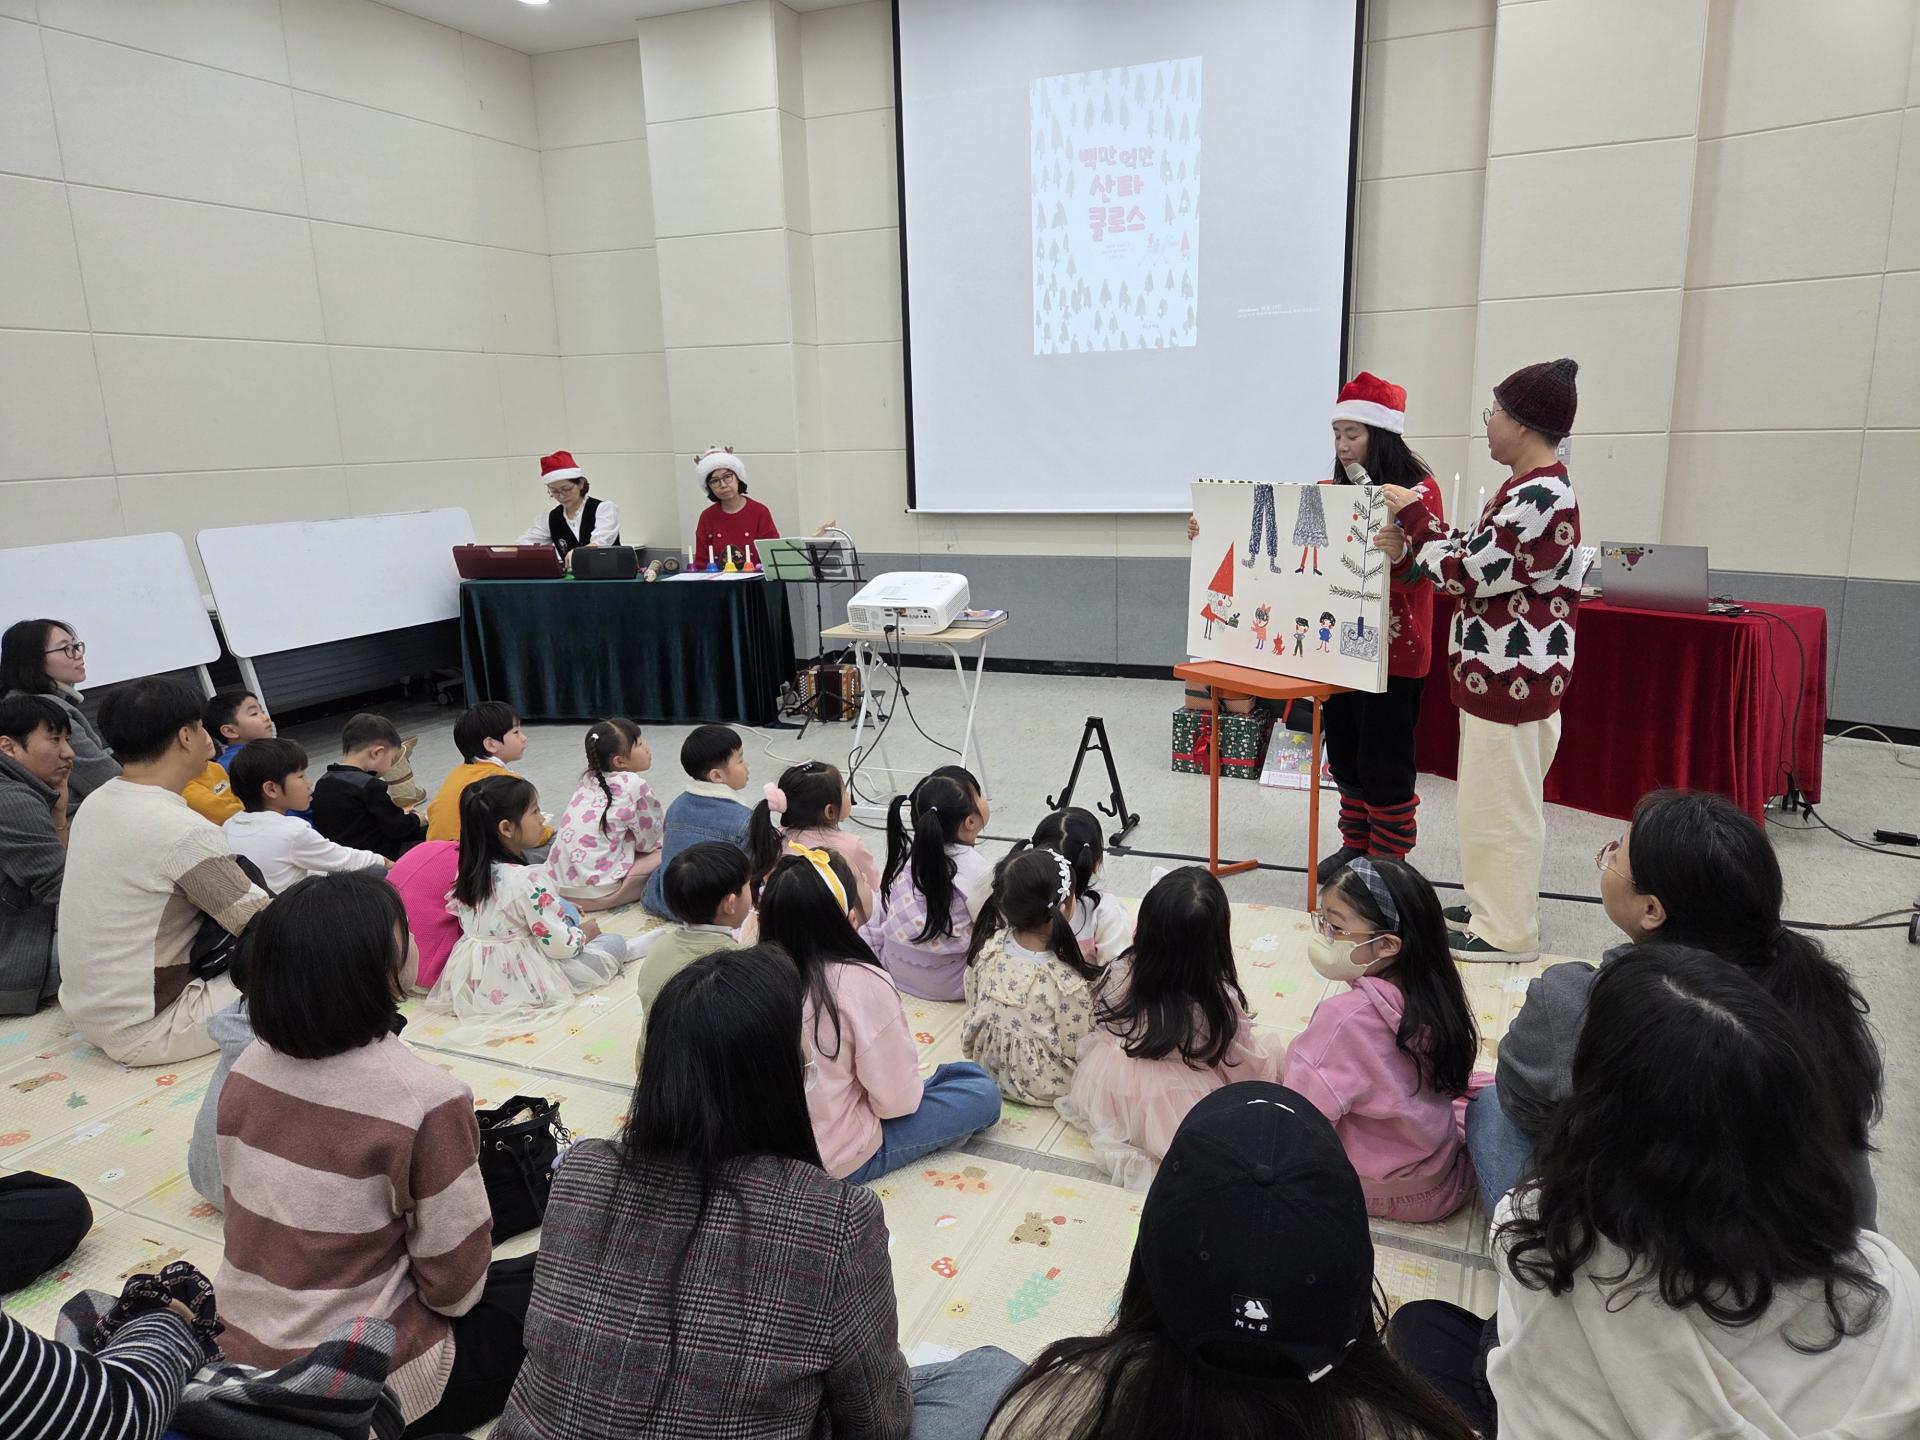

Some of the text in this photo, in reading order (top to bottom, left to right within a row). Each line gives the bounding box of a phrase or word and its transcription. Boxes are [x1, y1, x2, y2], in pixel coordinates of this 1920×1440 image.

[1079, 145, 1117, 170] 백만
[1089, 174, 1144, 203] 산타
[1088, 204, 1146, 242] 클로스
[1235, 1319, 1268, 1332] MLB
